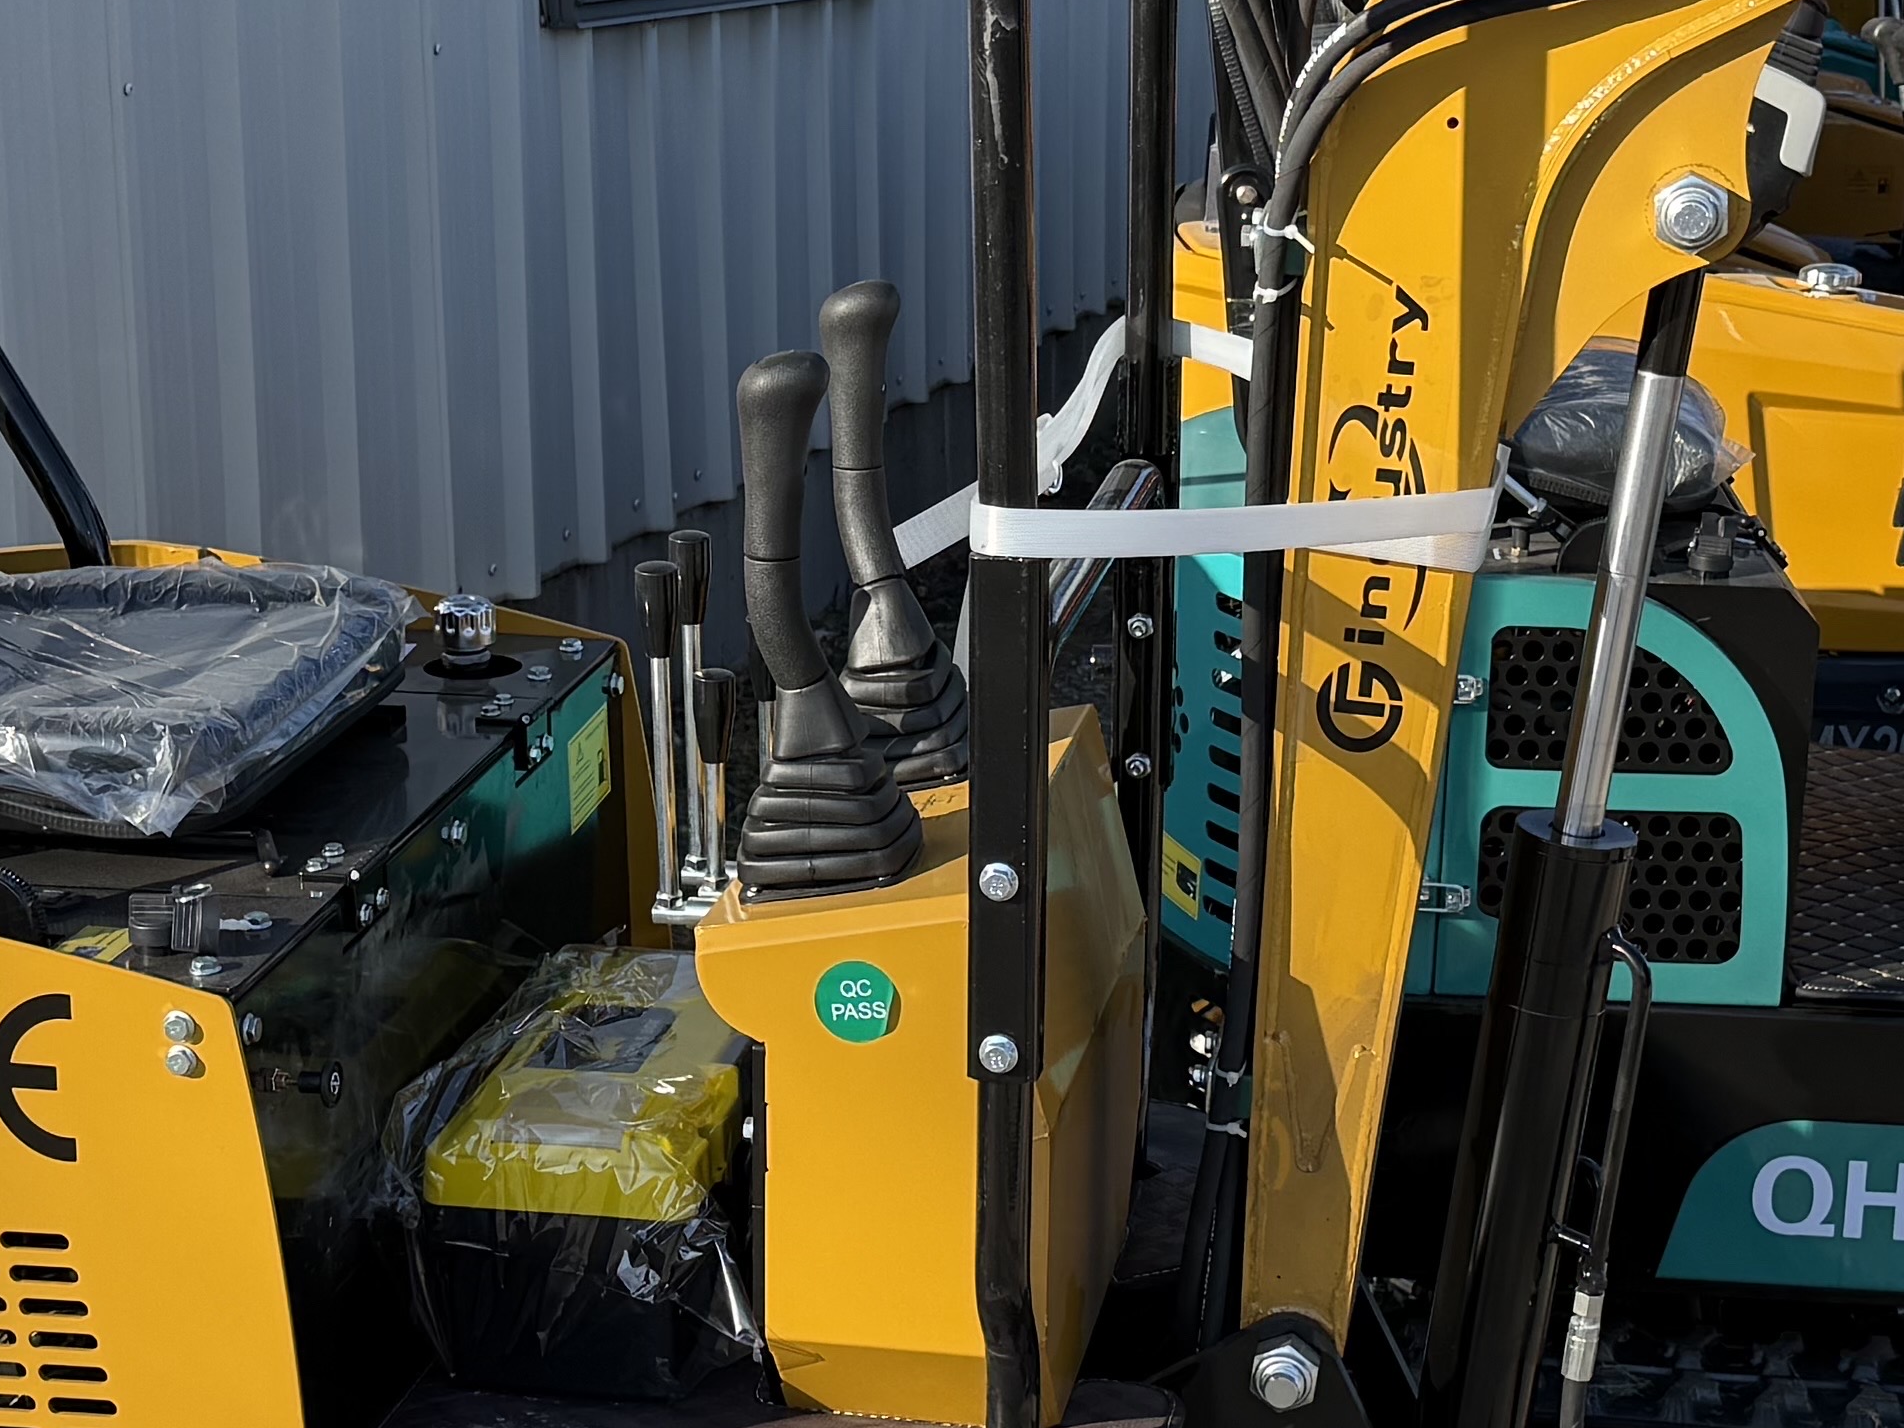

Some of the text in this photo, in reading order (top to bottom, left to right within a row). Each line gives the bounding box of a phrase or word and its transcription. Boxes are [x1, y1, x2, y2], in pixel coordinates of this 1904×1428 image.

[1343, 283, 1430, 647] inustry
[838, 978, 873, 999] QC
[830, 1001, 887, 1023] PASS
